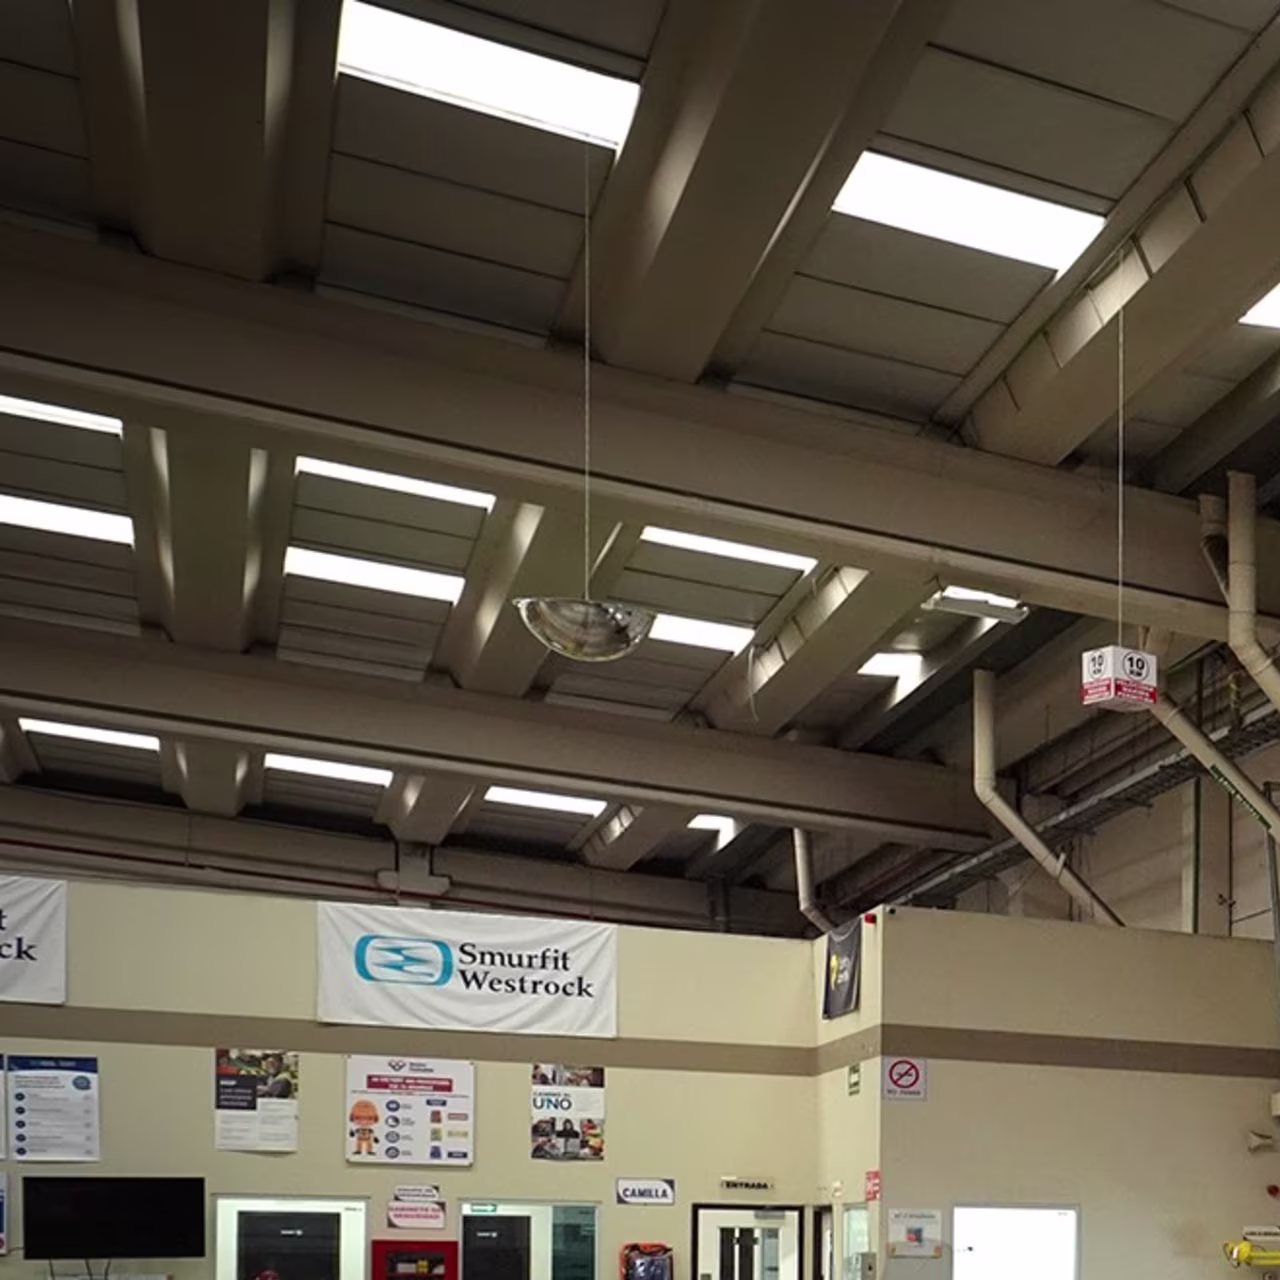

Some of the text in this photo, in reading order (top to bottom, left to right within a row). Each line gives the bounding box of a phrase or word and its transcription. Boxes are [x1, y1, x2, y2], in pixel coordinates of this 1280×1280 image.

[1091, 655, 1104, 667] 10
[1127, 656, 1145, 670] 10
[459, 942, 571, 971] Smurfit
[459, 969, 594, 998] Westrock
[533, 1098, 572, 1110] UNO
[622, 1188, 668, 1198] CAMILLA
